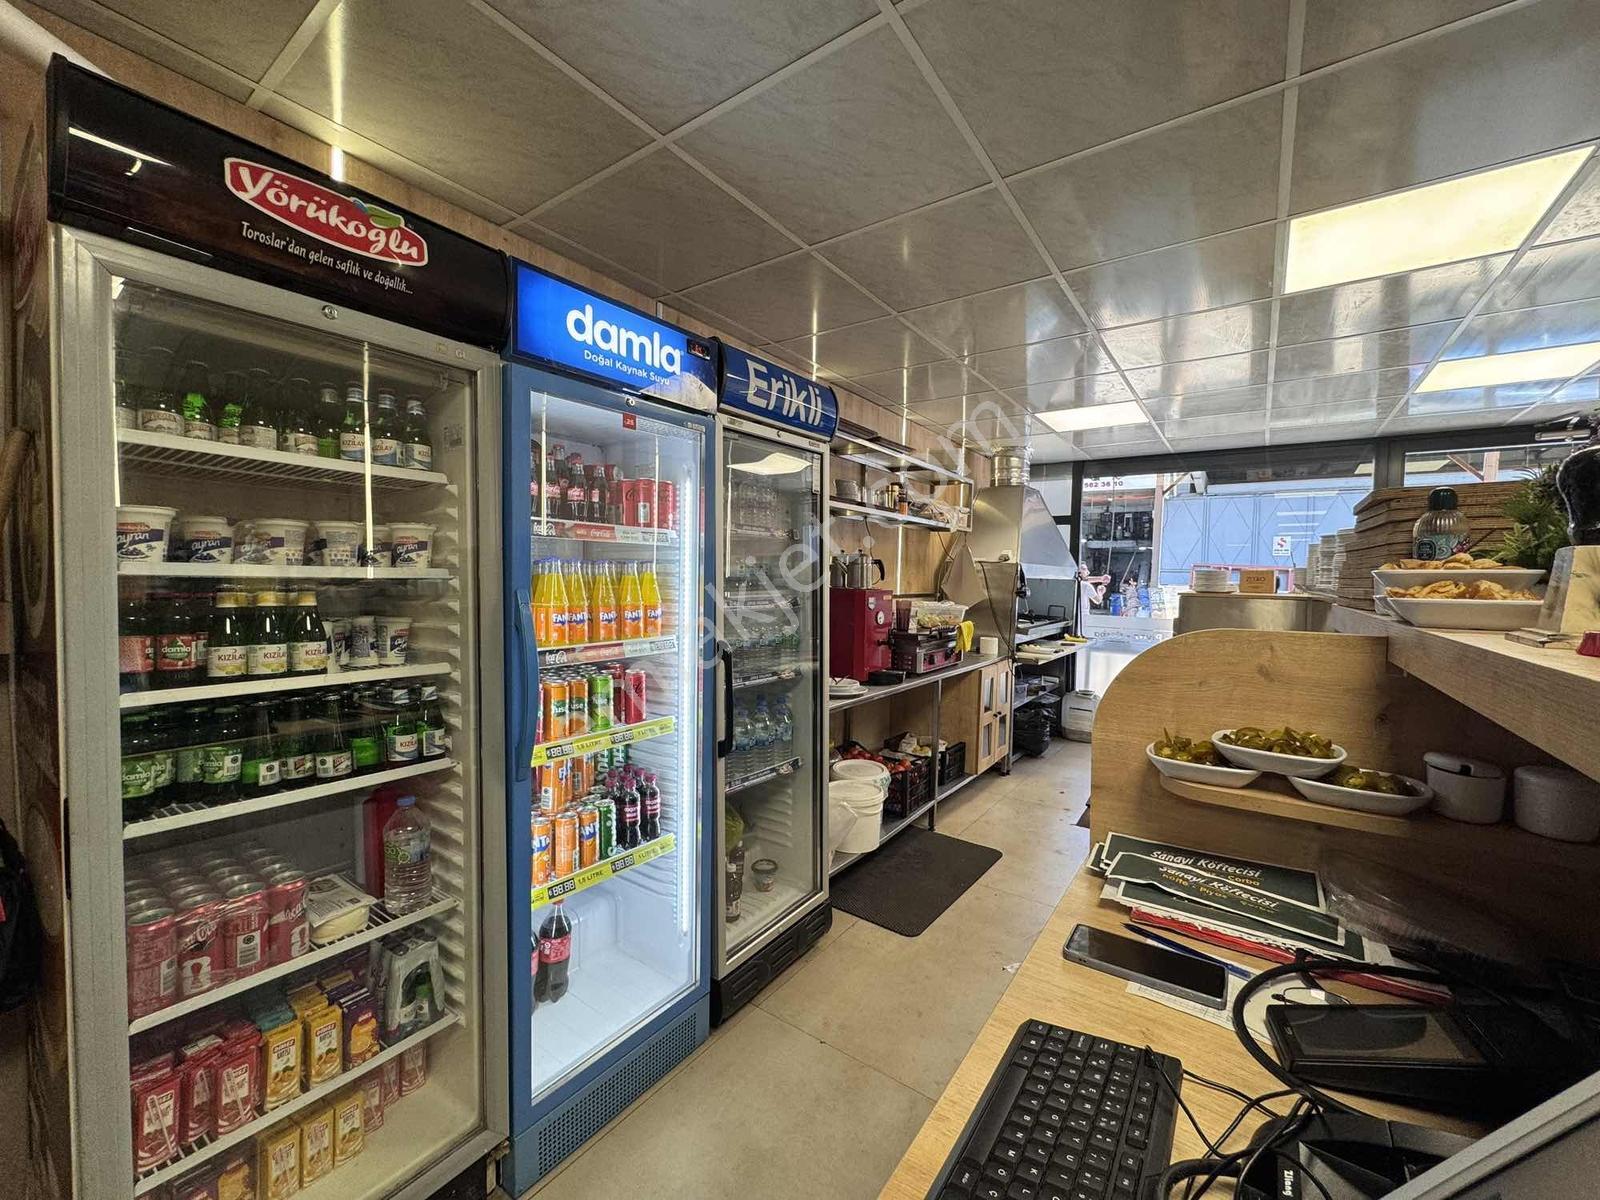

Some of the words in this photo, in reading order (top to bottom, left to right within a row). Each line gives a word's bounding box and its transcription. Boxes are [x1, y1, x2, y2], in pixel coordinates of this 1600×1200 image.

[241, 220, 307, 259] Toroslar'dan
[308, 248, 334, 268] gelen
[362, 268, 373, 281] ve
[566, 304, 681, 376] damla
[584, 349, 614, 369] Doğal
[615, 359, 649, 380] Kaynak
[649, 370, 671, 387] Suyu
[745, 358, 823, 427] Erikli
